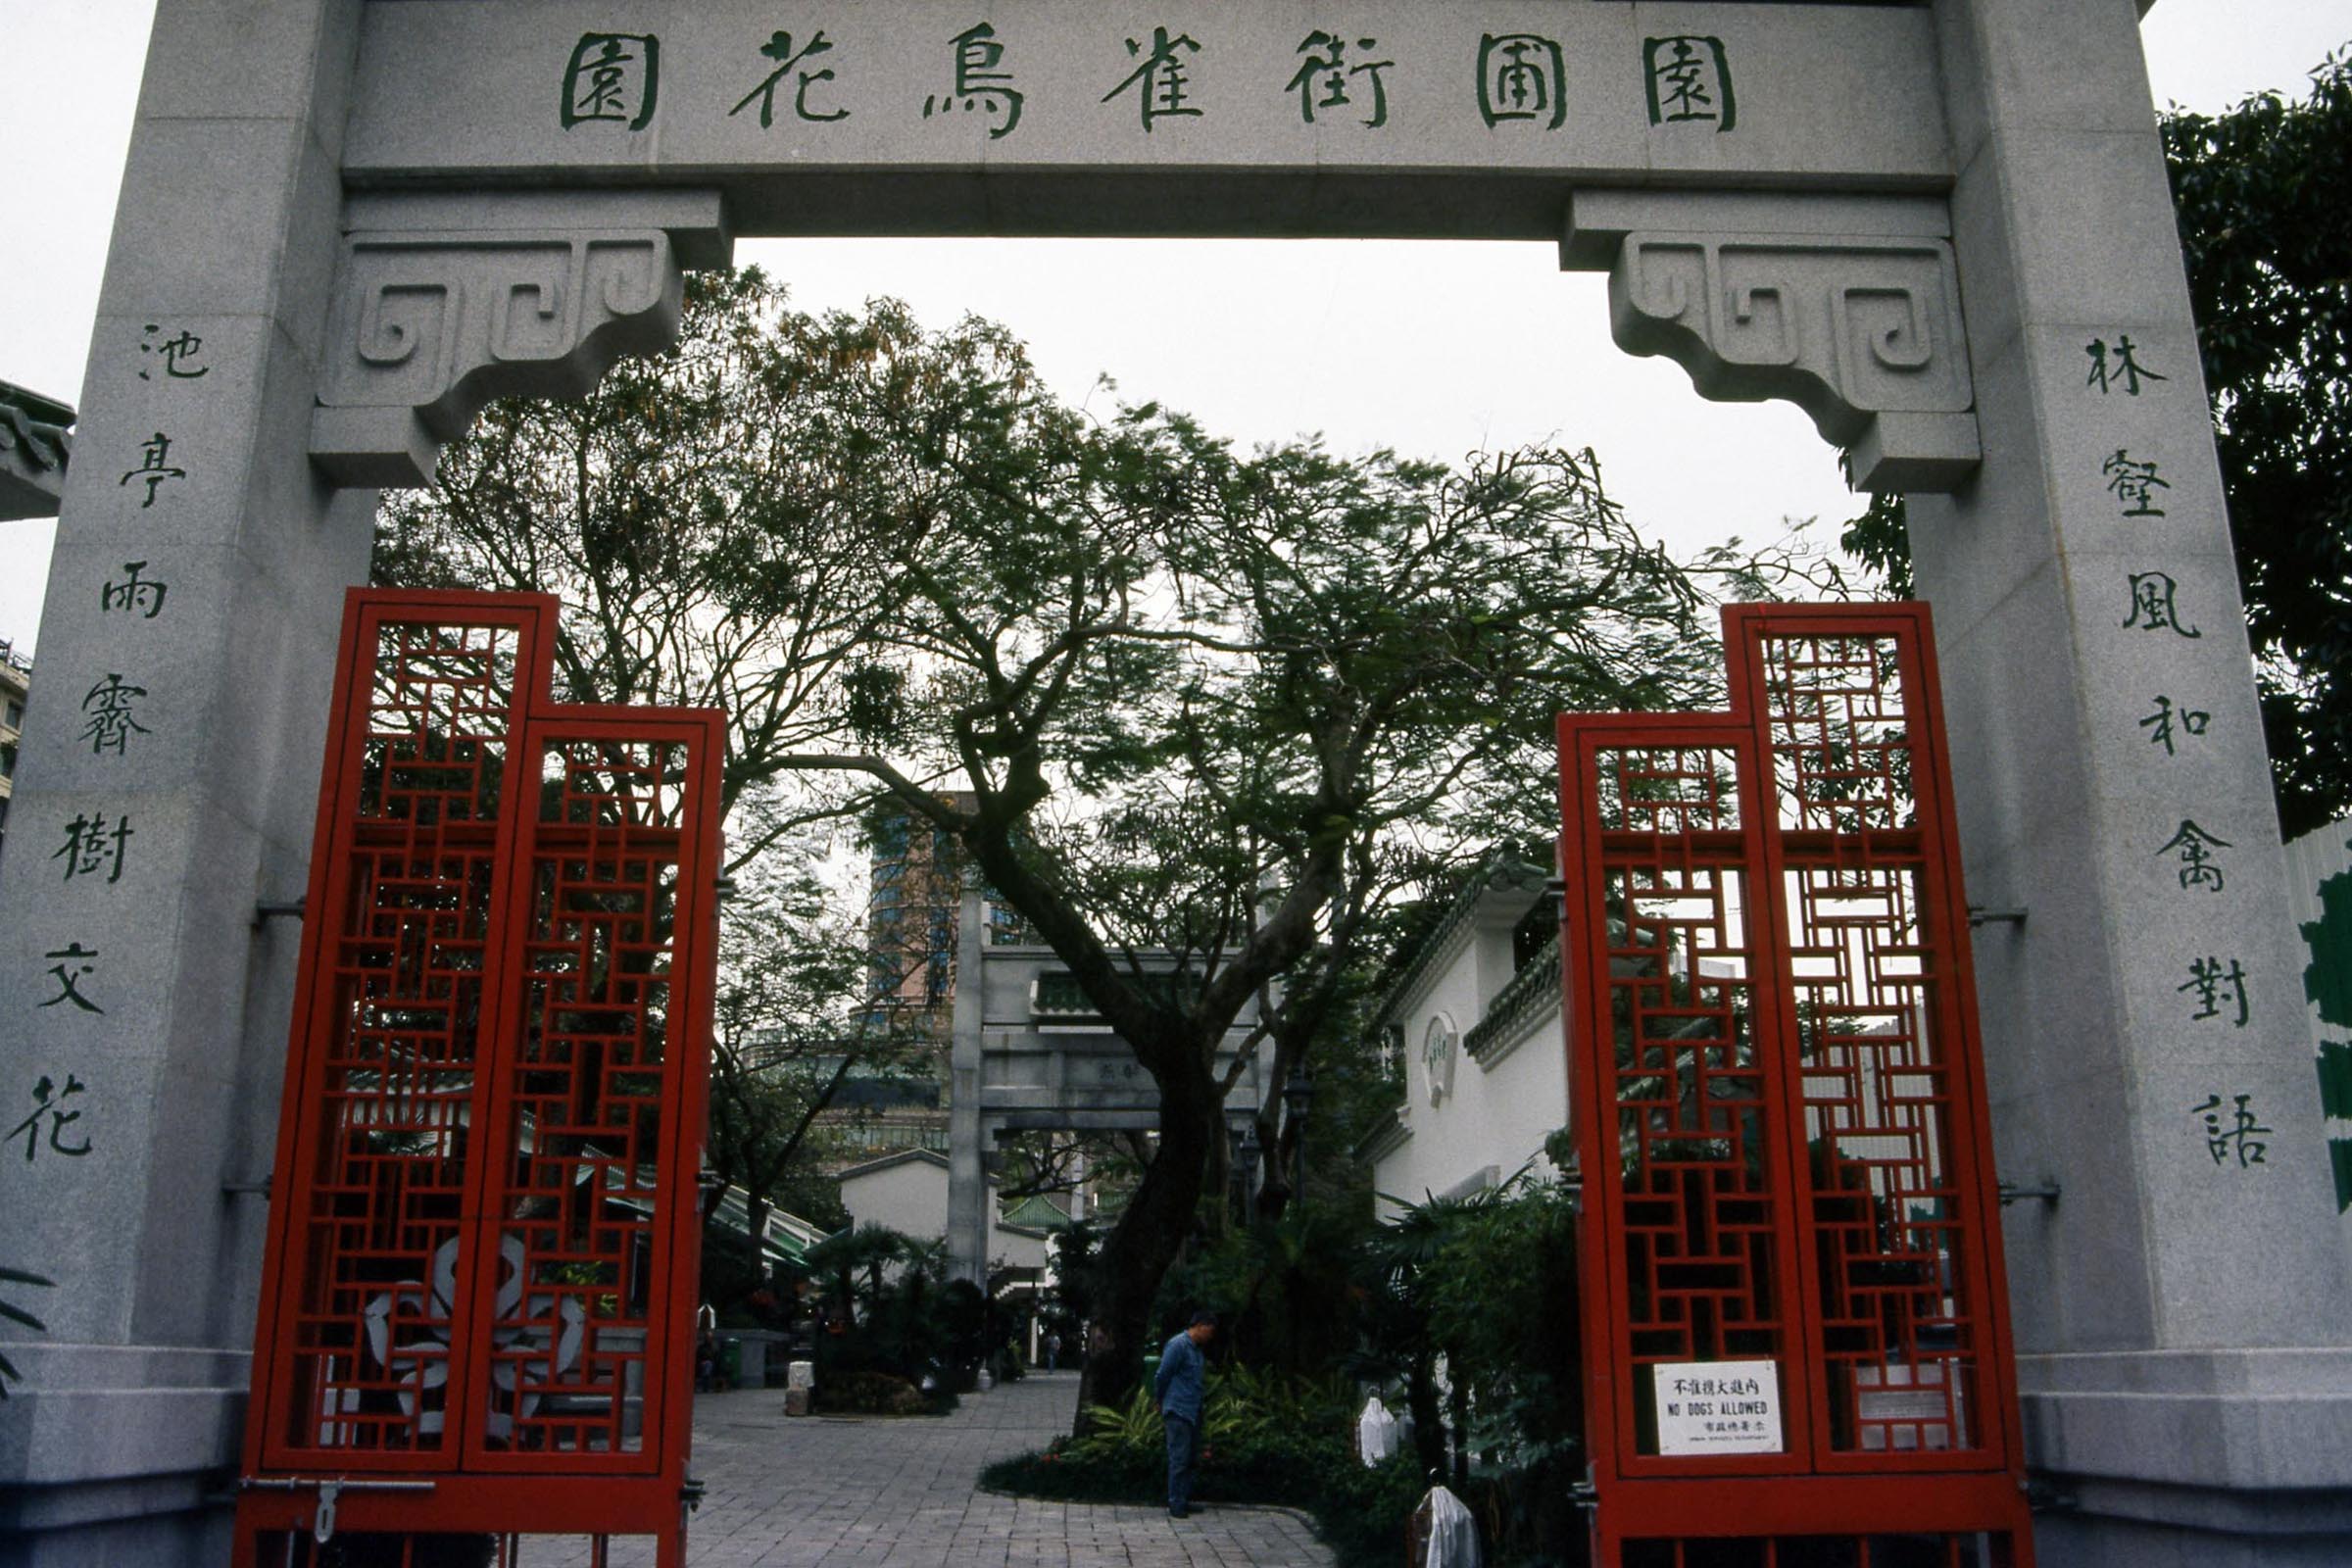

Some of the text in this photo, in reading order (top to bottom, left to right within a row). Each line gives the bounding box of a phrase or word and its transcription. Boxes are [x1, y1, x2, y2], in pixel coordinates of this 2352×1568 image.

[1667, 1401, 1768, 1417] NO DOGS ALLOWED
